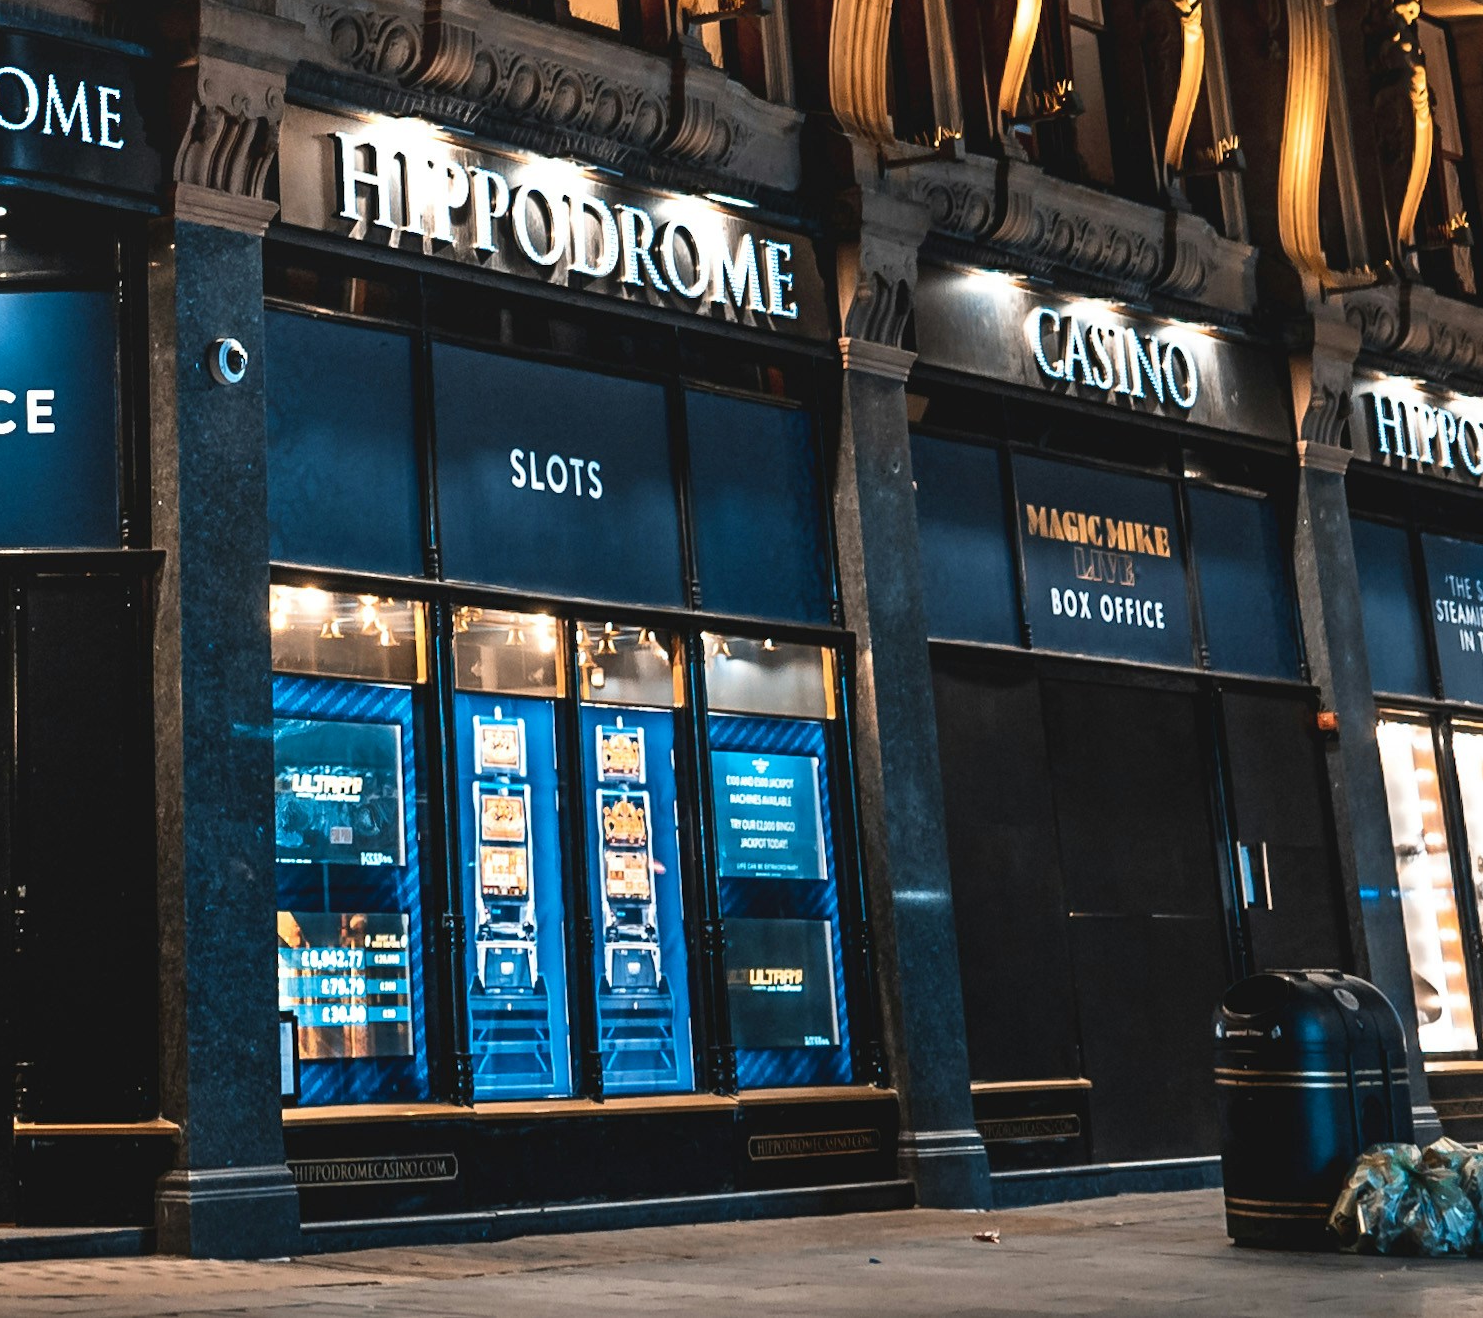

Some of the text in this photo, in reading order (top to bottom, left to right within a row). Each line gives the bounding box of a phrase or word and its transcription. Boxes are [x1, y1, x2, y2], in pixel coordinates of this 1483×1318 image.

[335, 131, 799, 320] HIPPODROME
[1025, 307, 1198, 408] CASINO
[510, 447, 603, 499] SLOTS
[1026, 504, 1170, 557] MAGIC MIKE
[1074, 547, 1135, 587] LIVE
[1050, 587, 1165, 629] BOX OFFICE
[1460, 629, 1475, 652] IN
[769, 778, 794, 789] JACKPOT
[740, 837, 766, 849] JACKPOT
[742, 819, 755, 830] OUR
[776, 821, 795, 832] BINGO
[294, 1160, 447, 1182] HIPPODROMECASINO.COM
